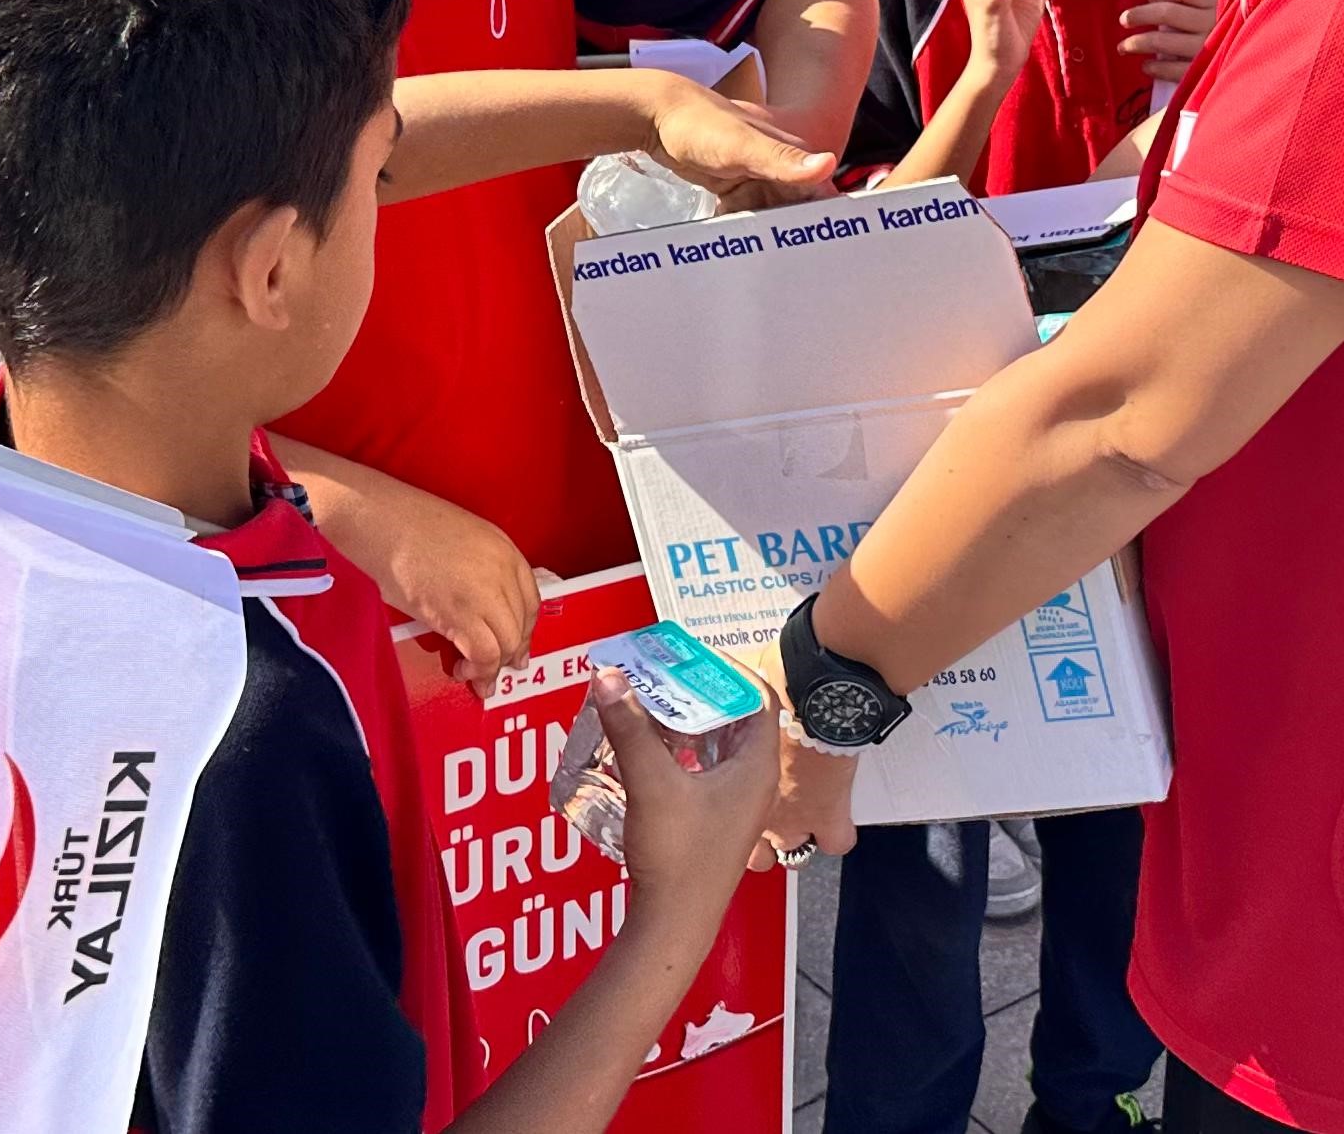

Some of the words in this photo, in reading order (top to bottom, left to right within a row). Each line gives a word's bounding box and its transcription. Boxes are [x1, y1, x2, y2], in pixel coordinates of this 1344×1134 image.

[574, 249, 661, 281] kardan
[667, 233, 764, 265] kardan
[771, 215, 870, 249] kardan
[878, 197, 980, 230] kardan
[666, 536, 741, 580] PET
[678, 575, 757, 599] PLASTIC
[760, 570, 813, 590] CUPS
[500, 666, 547, 695] 3-4
[932, 671, 957, 686] 458
[960, 669, 977, 684] 58
[979, 667, 996, 682] 60
